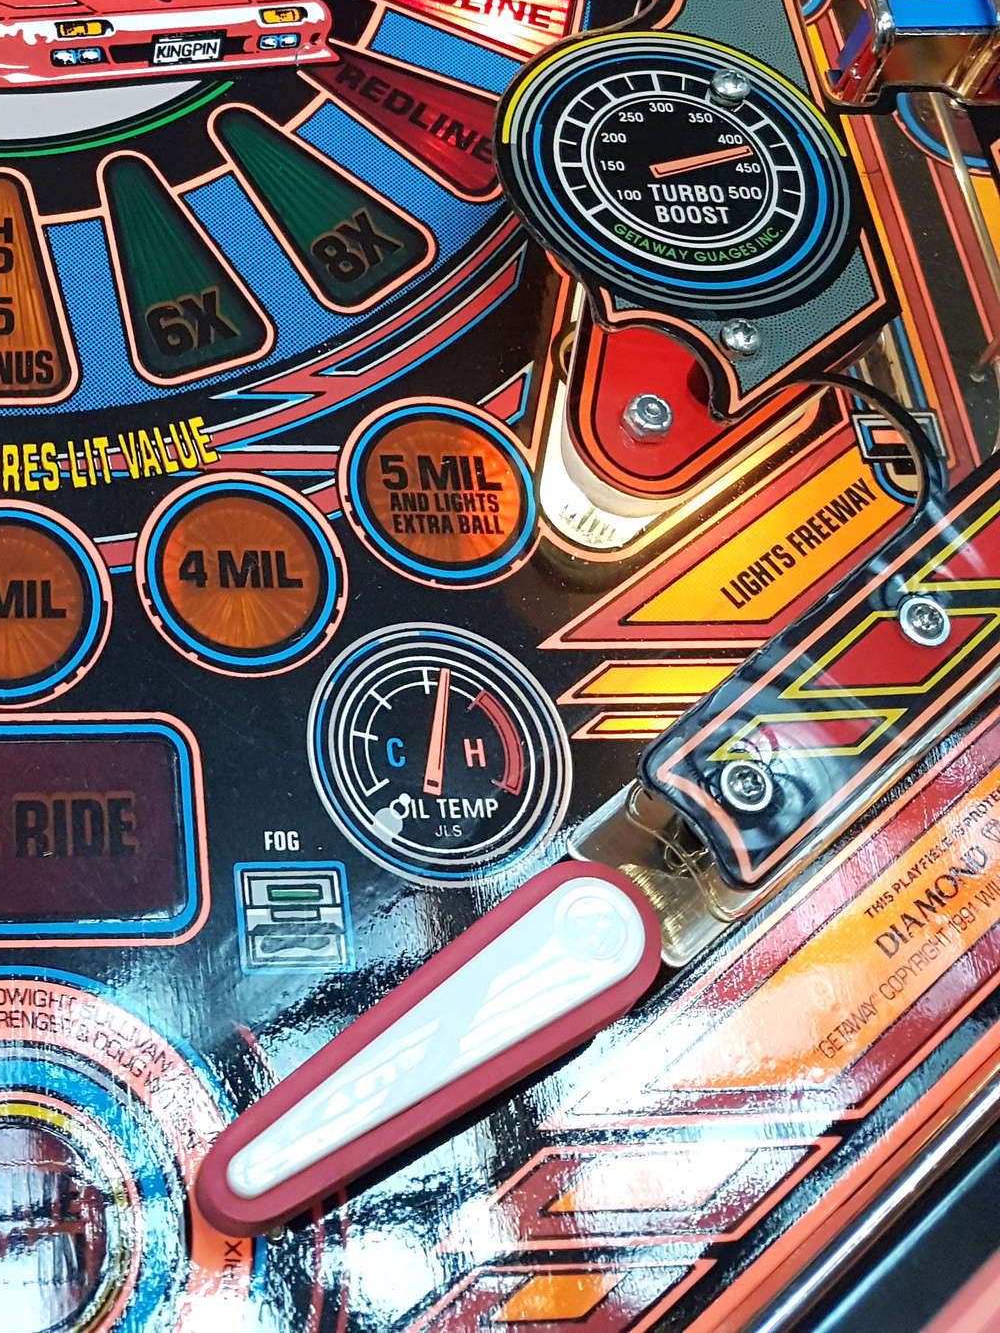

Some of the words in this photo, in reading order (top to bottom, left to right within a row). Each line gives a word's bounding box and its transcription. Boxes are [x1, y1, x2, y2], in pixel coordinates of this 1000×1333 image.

[155, 40, 221, 59] KINGPIN
[334, 58, 498, 167] REDLINE
[618, 112, 644, 123] 250
[649, 102, 674, 113] 300
[688, 112, 713, 123] 350
[601, 133, 627, 144] 200
[718, 134, 743, 145] 400
[600, 160, 625, 172] 150
[735, 162, 761, 173] 450
[616, 190, 642, 201] 100
[648, 184, 725, 203] TURBO
[729, 186, 763, 200] 500
[657, 206, 729, 225] BOOST
[310, 208, 404, 283] 8X
[612, 223, 689, 262] GETAWAY
[694, 241, 758, 263] GUAGES
[754, 228, 784, 253] INC.
[145, 288, 239, 356] 6X
[66, 436, 123, 491] LIT
[124, 416, 220, 481] VALUE
[379, 455, 409, 490] 5
[417, 454, 503, 492] MIL
[389, 492, 430, 512] AND
[433, 491, 500, 513] LIGHTS
[392, 513, 455, 534] EXTRA
[459, 513, 505, 536] BALL
[720, 544, 796, 609] LIGHTS
[785, 478, 877, 557] FREEWAY
[178, 550, 208, 588] 4
[217, 549, 304, 590] MIL
[386, 737, 406, 768] C
[463, 738, 487, 768] H
[389, 797, 430, 819] OIL
[436, 798, 499, 819] TEMP
[13, 790, 139, 859] RIDE
[435, 824, 462, 838] JLS
[263, 831, 300, 851] FOG
[864, 891, 895, 919] THIS
[874, 846, 987, 959] DIAMOND
[879, 930, 953, 1000] COPYRIGHT
[948, 903, 977, 934] 1991
